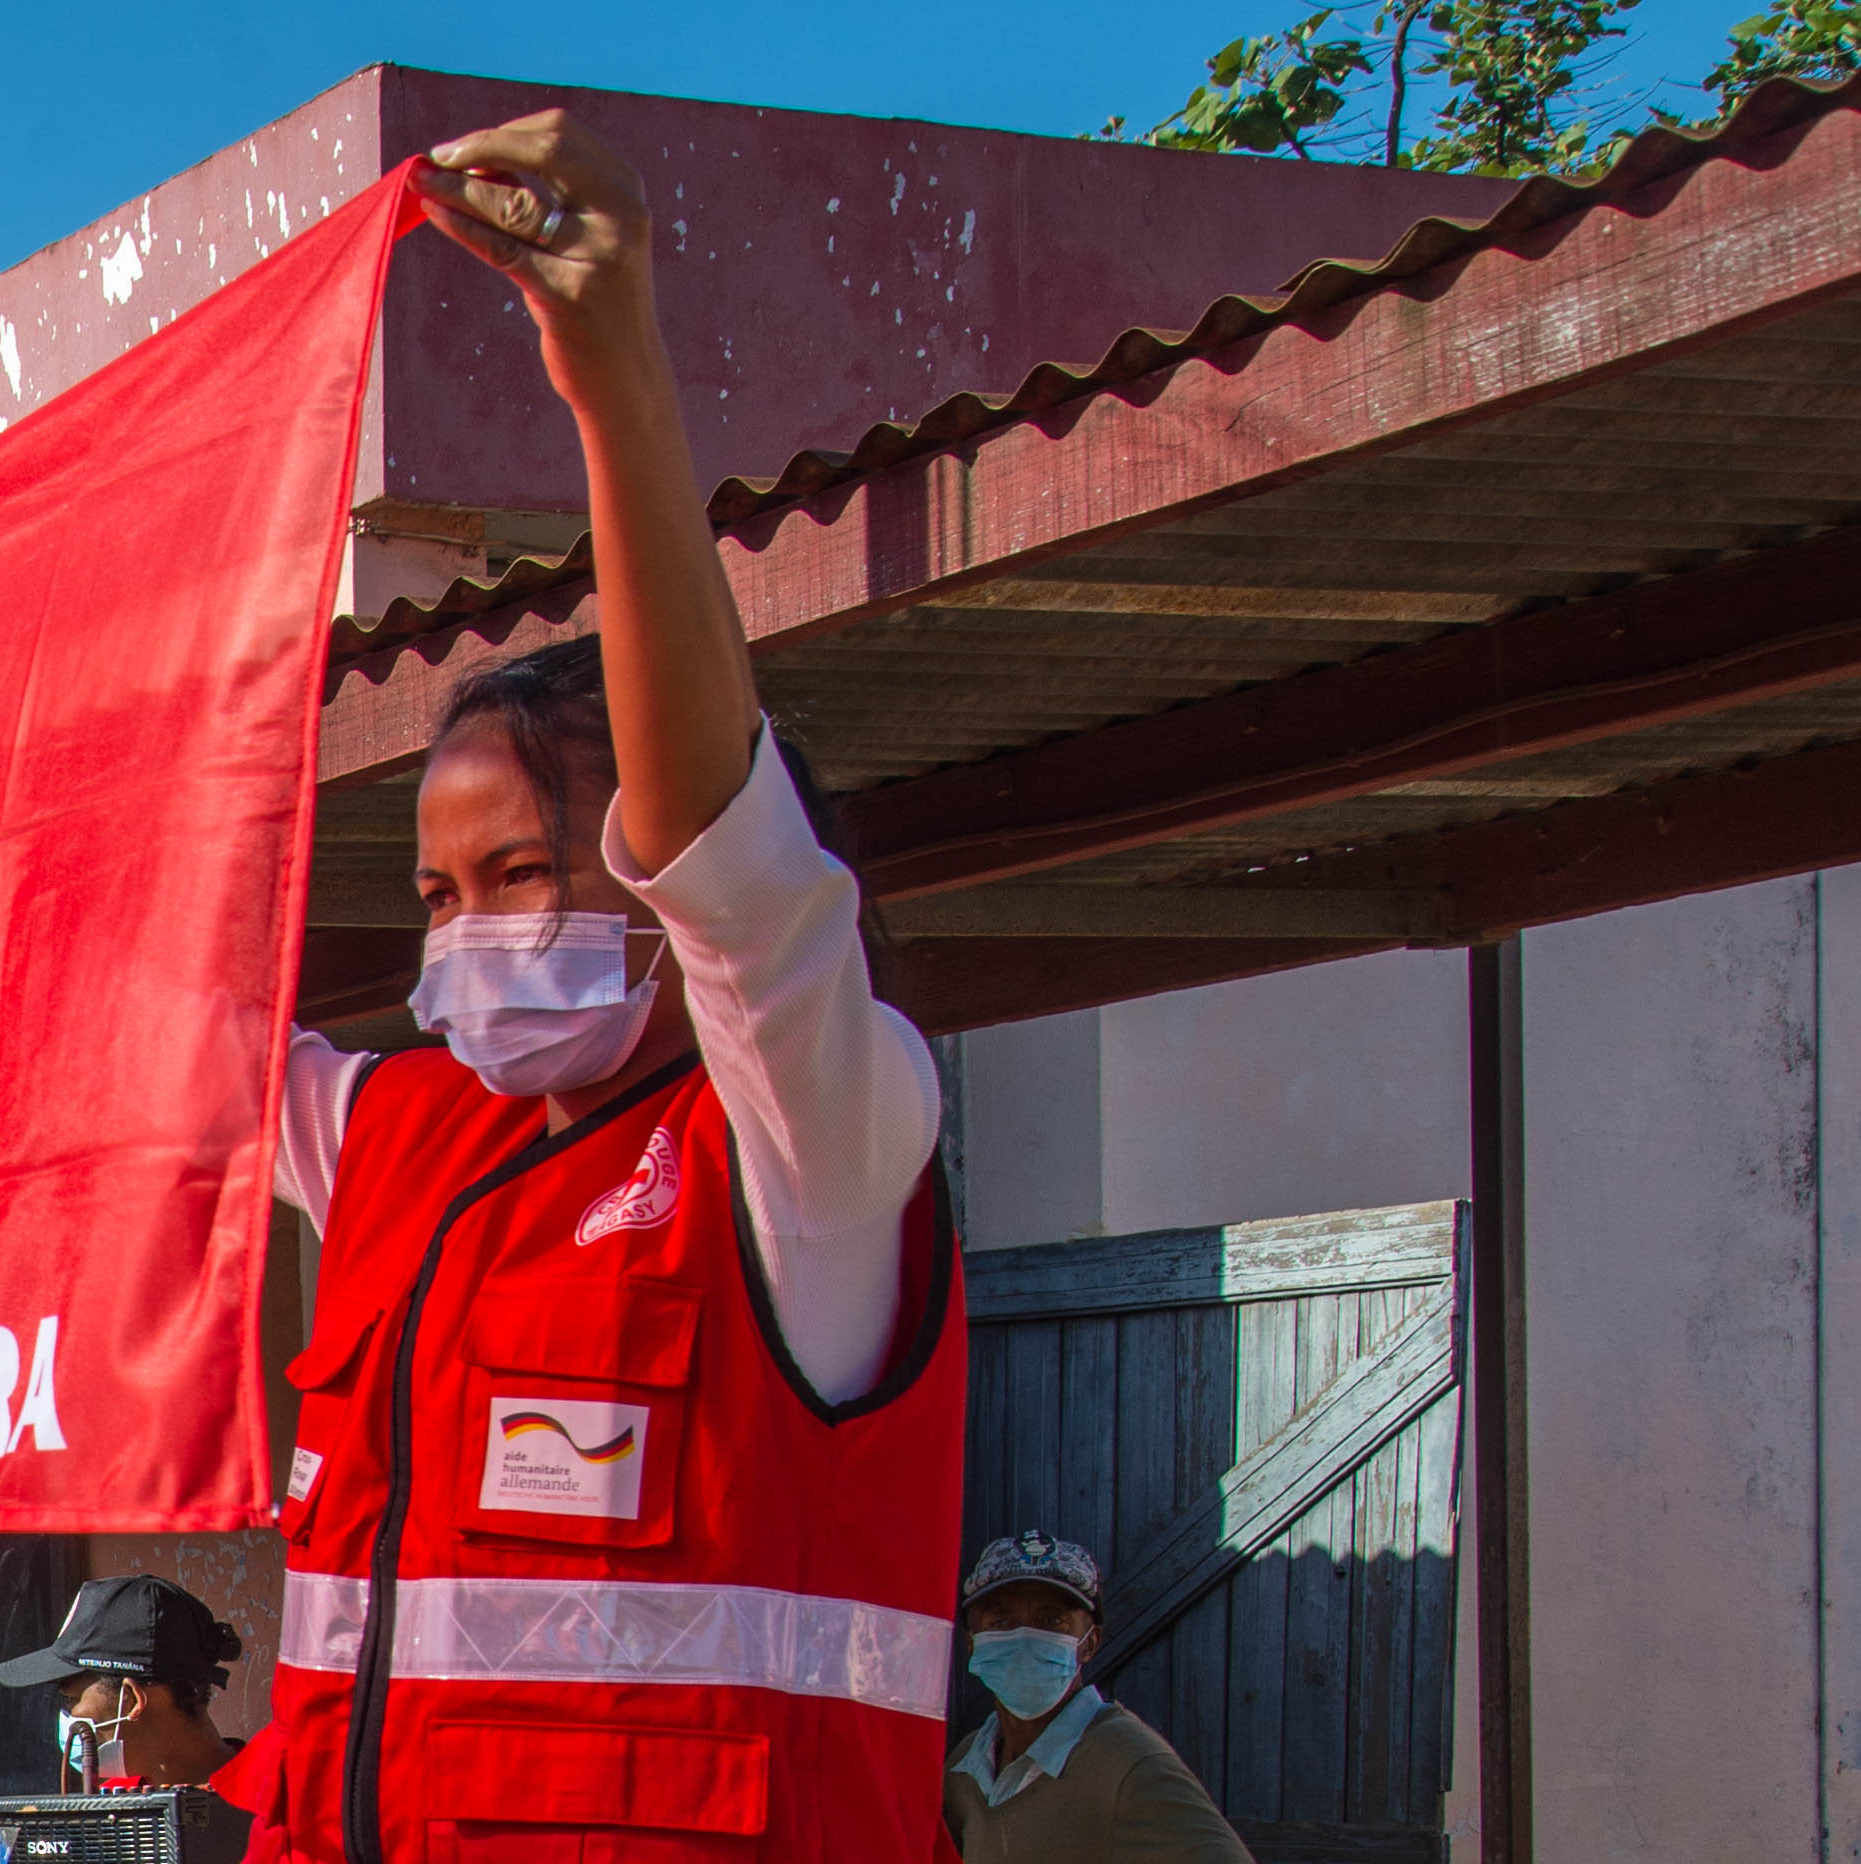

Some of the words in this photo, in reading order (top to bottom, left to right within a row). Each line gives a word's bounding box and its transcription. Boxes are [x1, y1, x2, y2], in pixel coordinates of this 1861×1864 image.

[503, 1450, 527, 1462] aide
[502, 1463, 571, 1477] humanitaire
[499, 1475, 580, 1493] allemande
[27, 1840, 70, 1855] SONY
